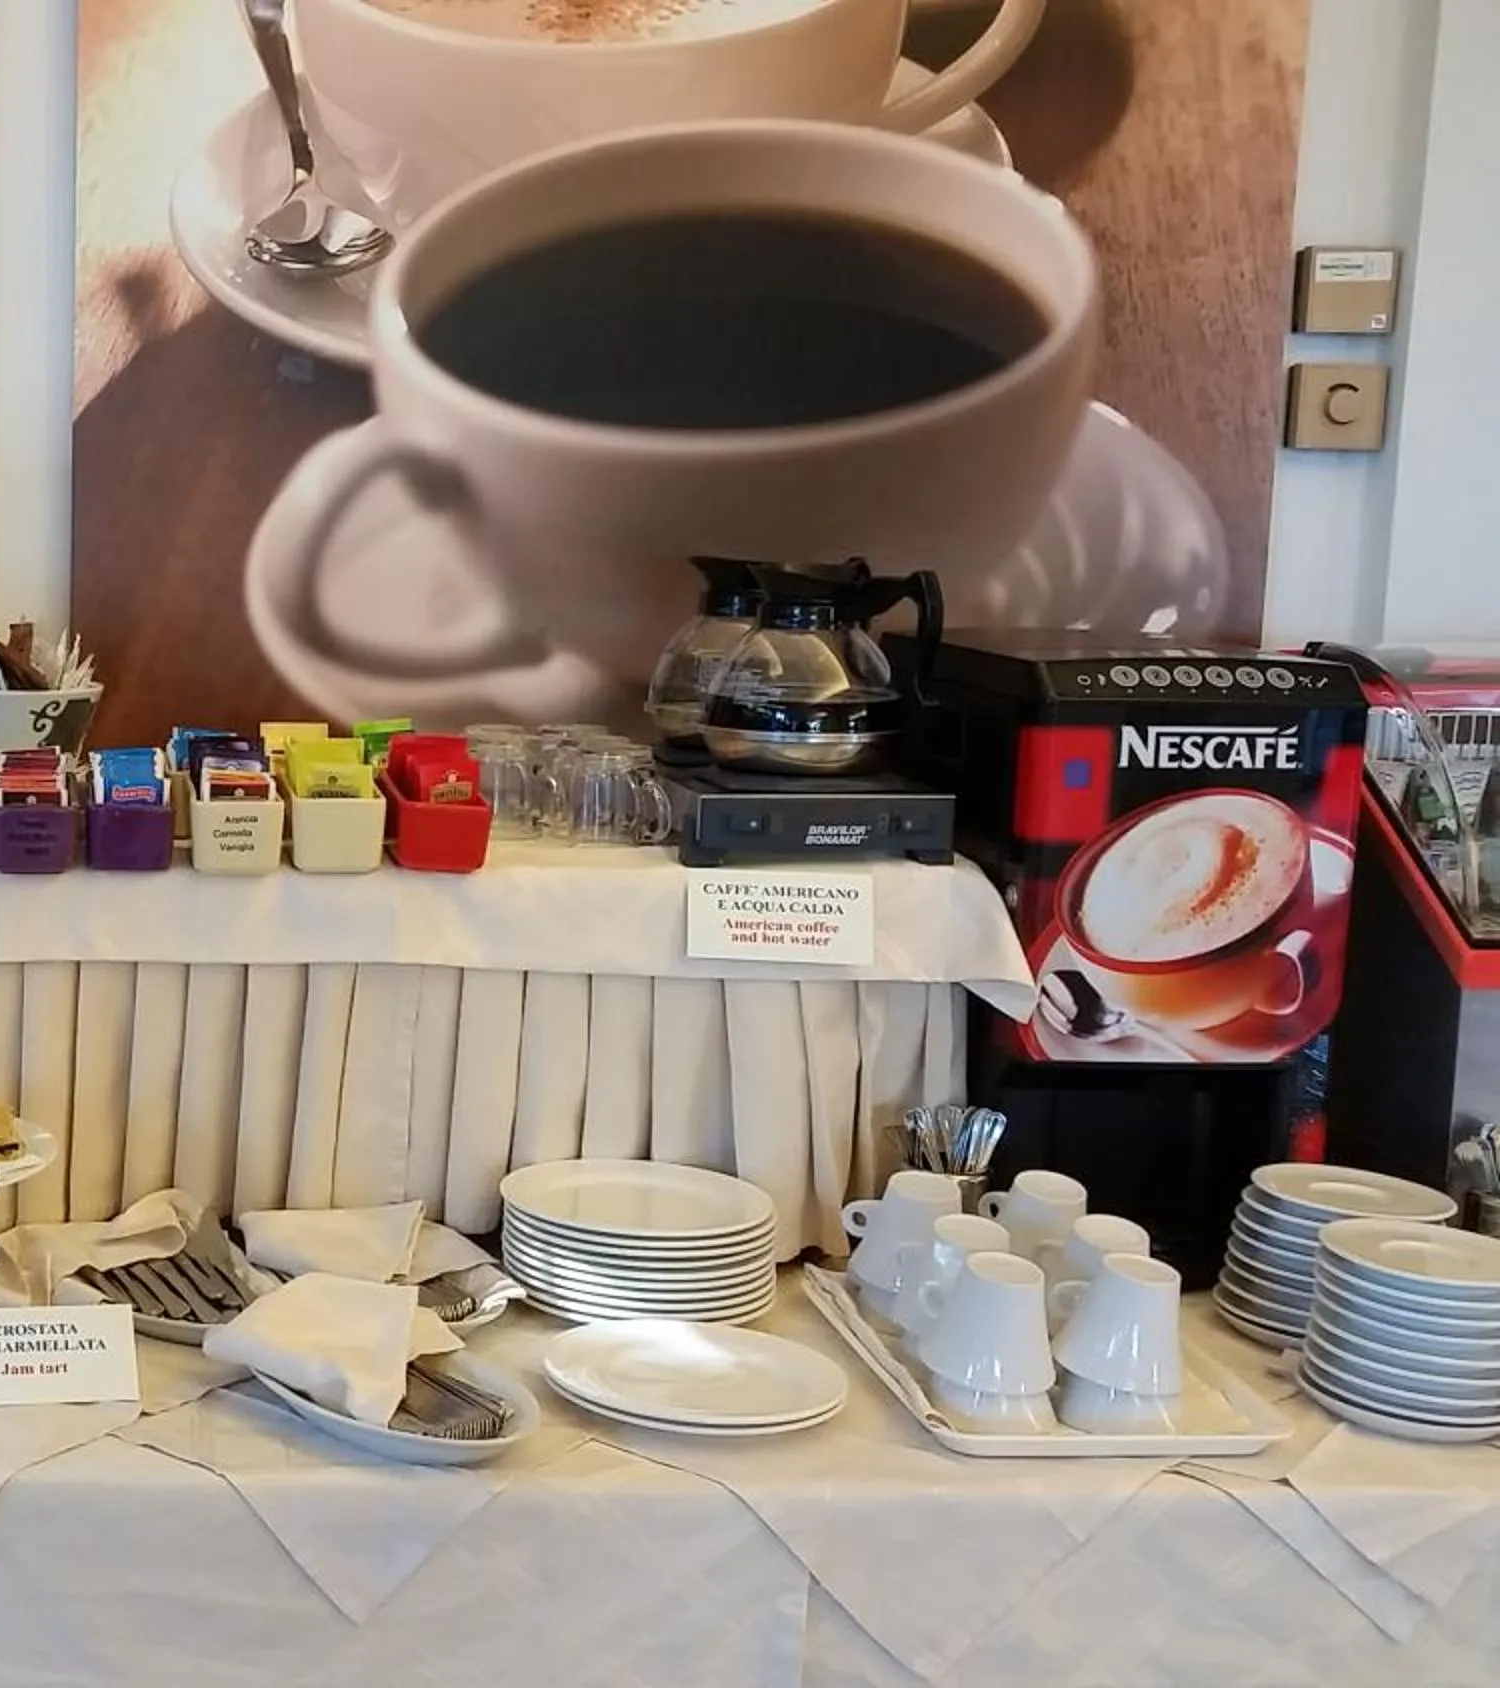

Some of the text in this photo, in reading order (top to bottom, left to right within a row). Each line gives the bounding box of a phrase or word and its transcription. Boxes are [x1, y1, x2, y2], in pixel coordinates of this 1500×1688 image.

[1118, 724, 1299, 769] NESCAFÉ
[761, 885, 860, 901] AMERICANO
[718, 900, 845, 915] E ACQUA CALDA
[724, 918, 840, 934] American coffee
[731, 931, 831, 946] and hot water
[0, 1362, 69, 1376] Jam tart
